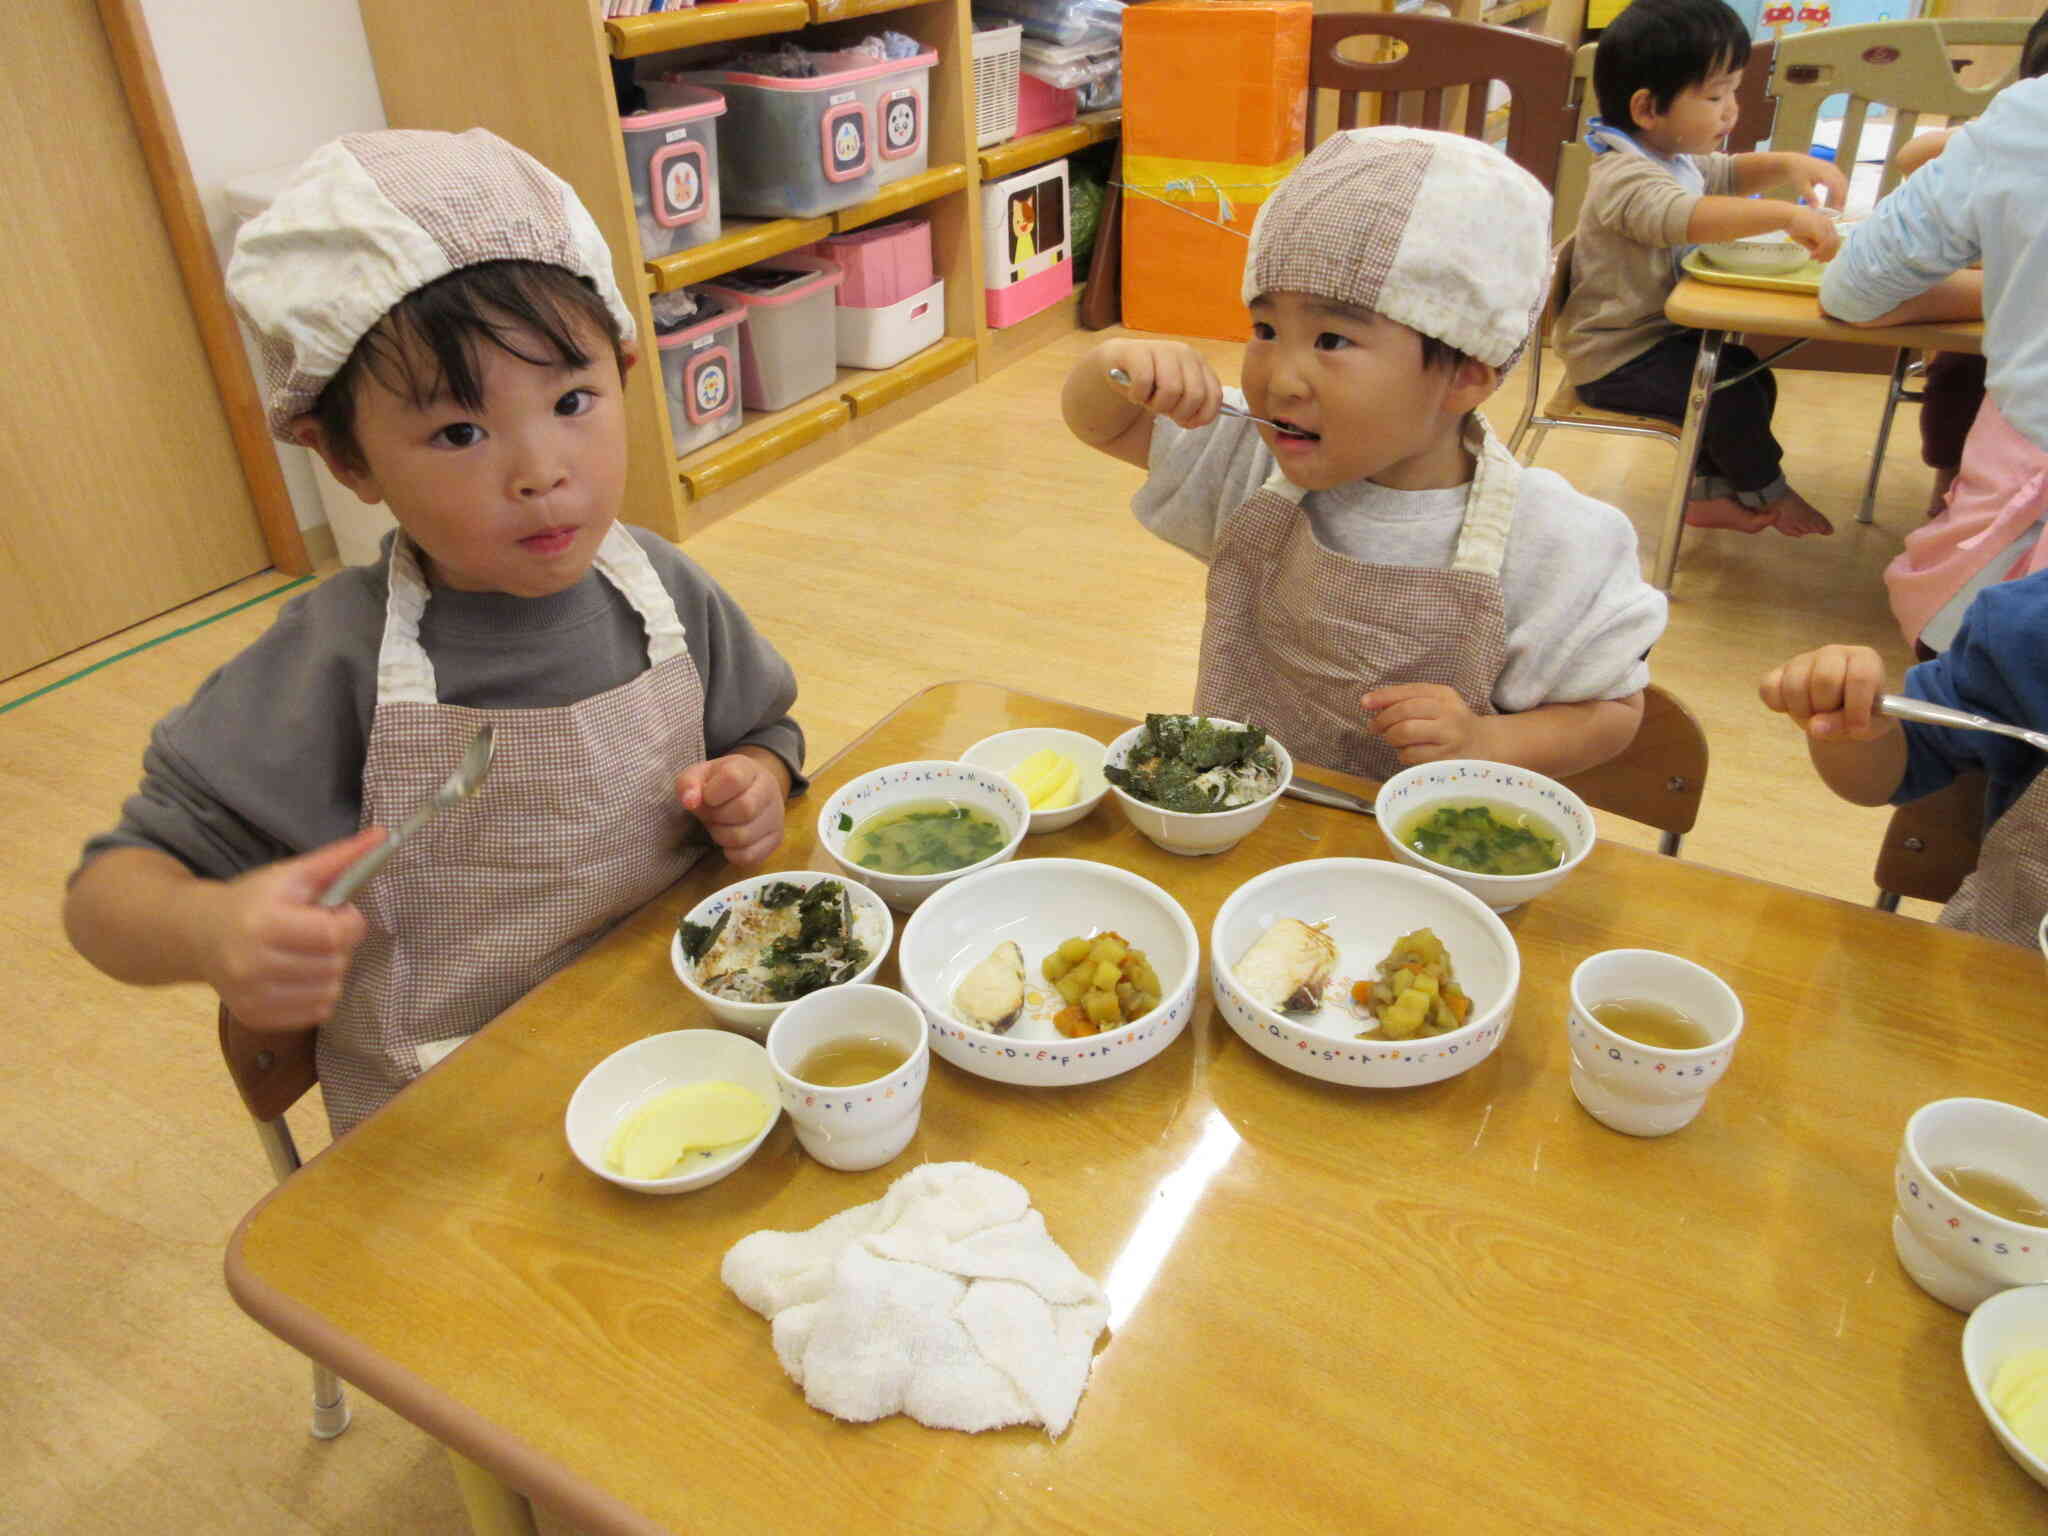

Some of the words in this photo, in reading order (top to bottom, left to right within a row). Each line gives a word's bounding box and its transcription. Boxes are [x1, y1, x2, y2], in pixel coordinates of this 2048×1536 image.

[1269, 1025, 1280, 1037] Q
[1323, 1050, 1333, 1061] S
[1062, 1056, 1070, 1067] F
[1608, 1048, 1622, 1061] Q
[1694, 1066, 1703, 1076] S
[1909, 1181, 1919, 1198] Q
[1994, 1243, 2009, 1255] S
